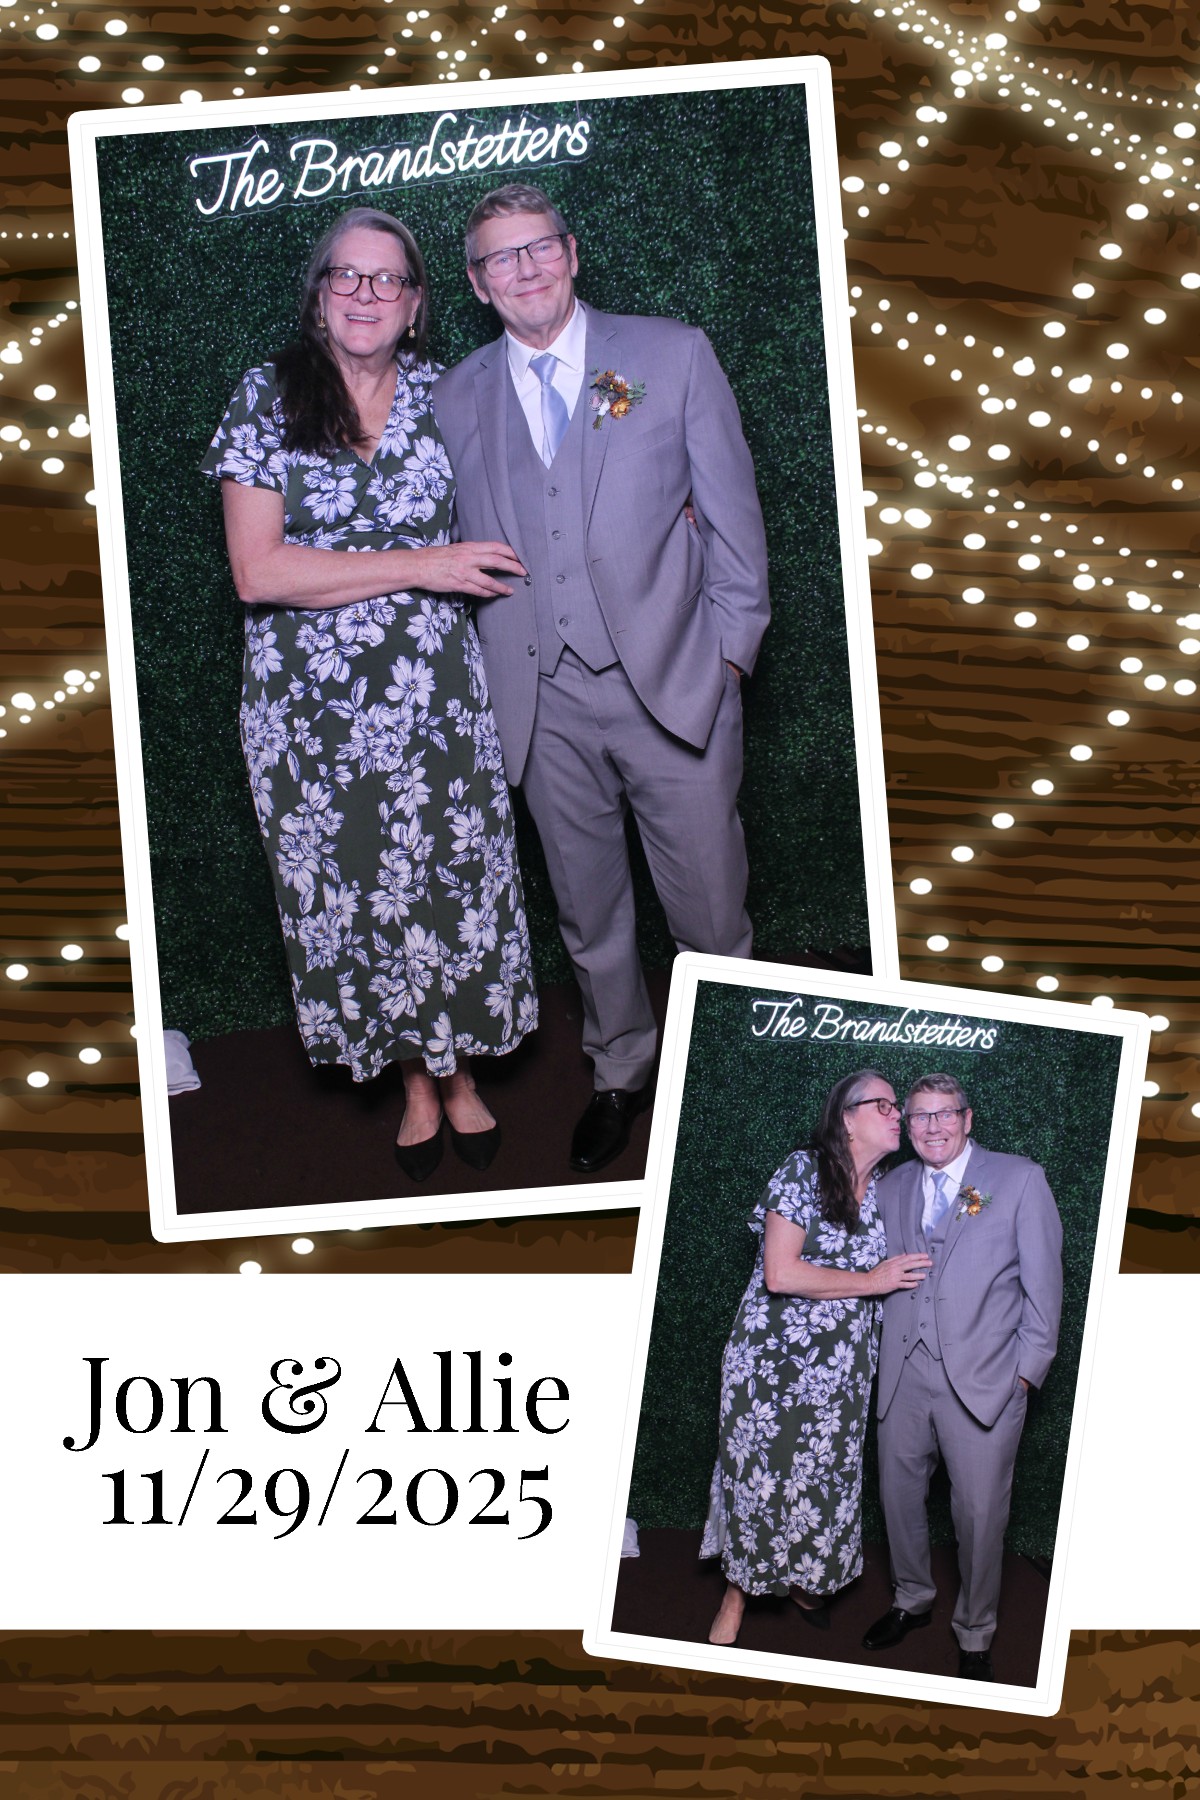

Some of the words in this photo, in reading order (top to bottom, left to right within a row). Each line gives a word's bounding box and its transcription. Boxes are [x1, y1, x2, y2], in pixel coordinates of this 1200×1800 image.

[189, 139, 285, 216] The
[290, 112, 590, 199] Brandstetters
[751, 997, 806, 1038] The
[811, 1003, 998, 1050] Brandstetters
